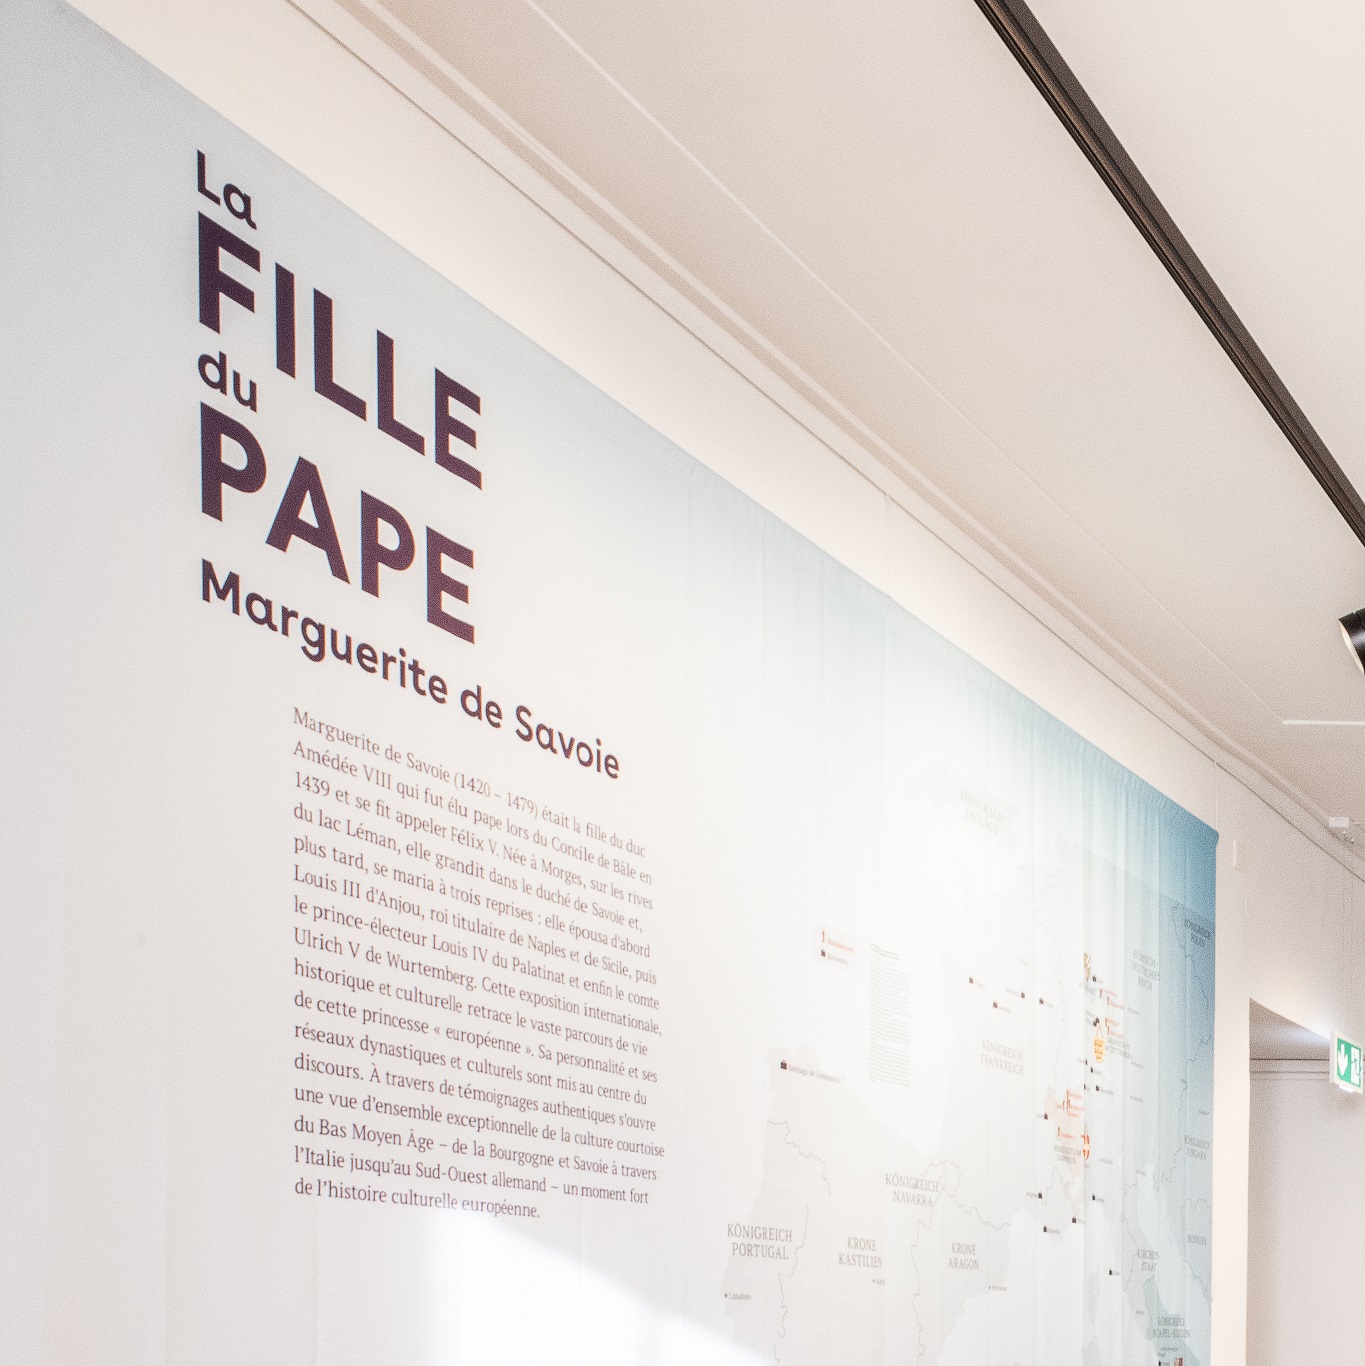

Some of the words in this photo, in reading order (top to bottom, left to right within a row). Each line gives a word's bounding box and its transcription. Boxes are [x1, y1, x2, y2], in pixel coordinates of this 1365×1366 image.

[197, 149, 257, 229] La
[197, 350, 257, 412] du
[198, 211, 482, 490] FILLE
[199, 400, 475, 644] PAPE
[201, 558, 448, 704] Marguerite
[460, 684, 502, 728] de
[514, 704, 620, 780] Savoie
[292, 706, 381, 756] Marguerite
[383, 743, 402, 765] de
[405, 751, 451, 784] Savoie
[452, 773, 491, 798] (1420
[505, 791, 539, 820] 1479)
[539, 808, 570, 830] était
[571, 816, 582, 835] la
[584, 821, 608, 844] fille
[607, 831, 624, 851] du
[624, 838, 646, 859] duc
[292, 739, 359, 778] Amédée
[361, 764, 392, 791] VIII
[394, 781, 420, 801] qui
[422, 786, 444, 809] fut
[446, 798, 468, 819] élu
[471, 808, 503, 831] pape
[505, 817, 530, 841] lors
[531, 828, 548, 848] du
[549, 835, 595, 865] Concile
[595, 852, 611, 870] de
[611, 857, 637, 880] Bâle
[637, 871, 653, 886] en
[292, 801, 314, 824] du
[317, 808, 342, 833] lac
[345, 818, 402, 855] Léman,
[404, 840, 432, 863] elle
[433, 852, 485, 880] grandit
[487, 866, 519, 891] dans
[520, 877, 533, 896] le
[534, 883, 572, 908] duché
[572, 896, 589, 914] de
[590, 901, 626, 926] Savoie
[626, 917, 644, 934] et,
[292, 926, 343, 956] Ulrich
[346, 940, 361, 959] V
[364, 945, 383, 965] de
[385, 950, 478, 992] Wurtemberg.
[480, 975, 516, 999] Cette
[517, 989, 580, 1016] exposition
[582, 1001, 663, 1038] internationale,
[293, 894, 309, 916] le
[311, 905, 428, 948] prince-électeur
[430, 933, 469, 959] Louis
[471, 945, 489, 964] IV
[490, 951, 509, 970] du
[510, 955, 566, 986] Palatinat
[567, 975, 580, 989] et
[581, 979, 613, 998] enfin
[613, 984, 625, 1001] le
[625, 992, 660, 1011] comte
[292, 956, 375, 994] historique
[377, 982, 392, 998] et
[394, 985, 463, 1014] culturelle
[466, 1003, 513, 1026] retrace
[514, 1010, 527, 1029] le
[528, 1018, 562, 1037] vaste
[563, 1026, 614, 1049] parcours
[614, 1035, 630, 1053] de
[630, 1040, 649, 1057] vie
[292, 1051, 364, 1081] discours.
[367, 1067, 381, 1084] À
[384, 1070, 435, 1093] travers
[437, 1078, 455, 1097] de
[456, 1082, 539, 1113] témoignages
[540, 1100, 617, 1126] authentiques
[293, 1087, 324, 1105] une
[327, 1092, 358, 1110] vue
[445, 1112, 539, 1139] exceptionnelle
[540, 1123, 558, 1141] de
[559, 1126, 572, 1143] la
[572, 1130, 615, 1150] culture
[615, 1139, 666, 1158] courtoise
[293, 1176, 314, 1196] de
[389, 1188, 459, 1209] culturelle
[459, 1199, 541, 1219] européenne.
[414, 1161, 488, 1186] Sud-Ouest
[490, 1171, 547, 1193] allemand
[561, 1183, 579, 1197] un
[579, 1185, 627, 1202] moment
[628, 1187, 649, 1205] fort
[885, 1173, 939, 1193] KÖNIGREICH
[893, 1191, 934, 1208] NAVARRA
[727, 1223, 792, 1242] KÖNIGREICH
[732, 1242, 789, 1260] PORTUGAL
[838, 1253, 883, 1268] KASTILIEN
[847, 1236, 877, 1252] KRONE
[948, 1258, 980, 1270] ARAGON
[951, 1242, 977, 1255] KRONE
